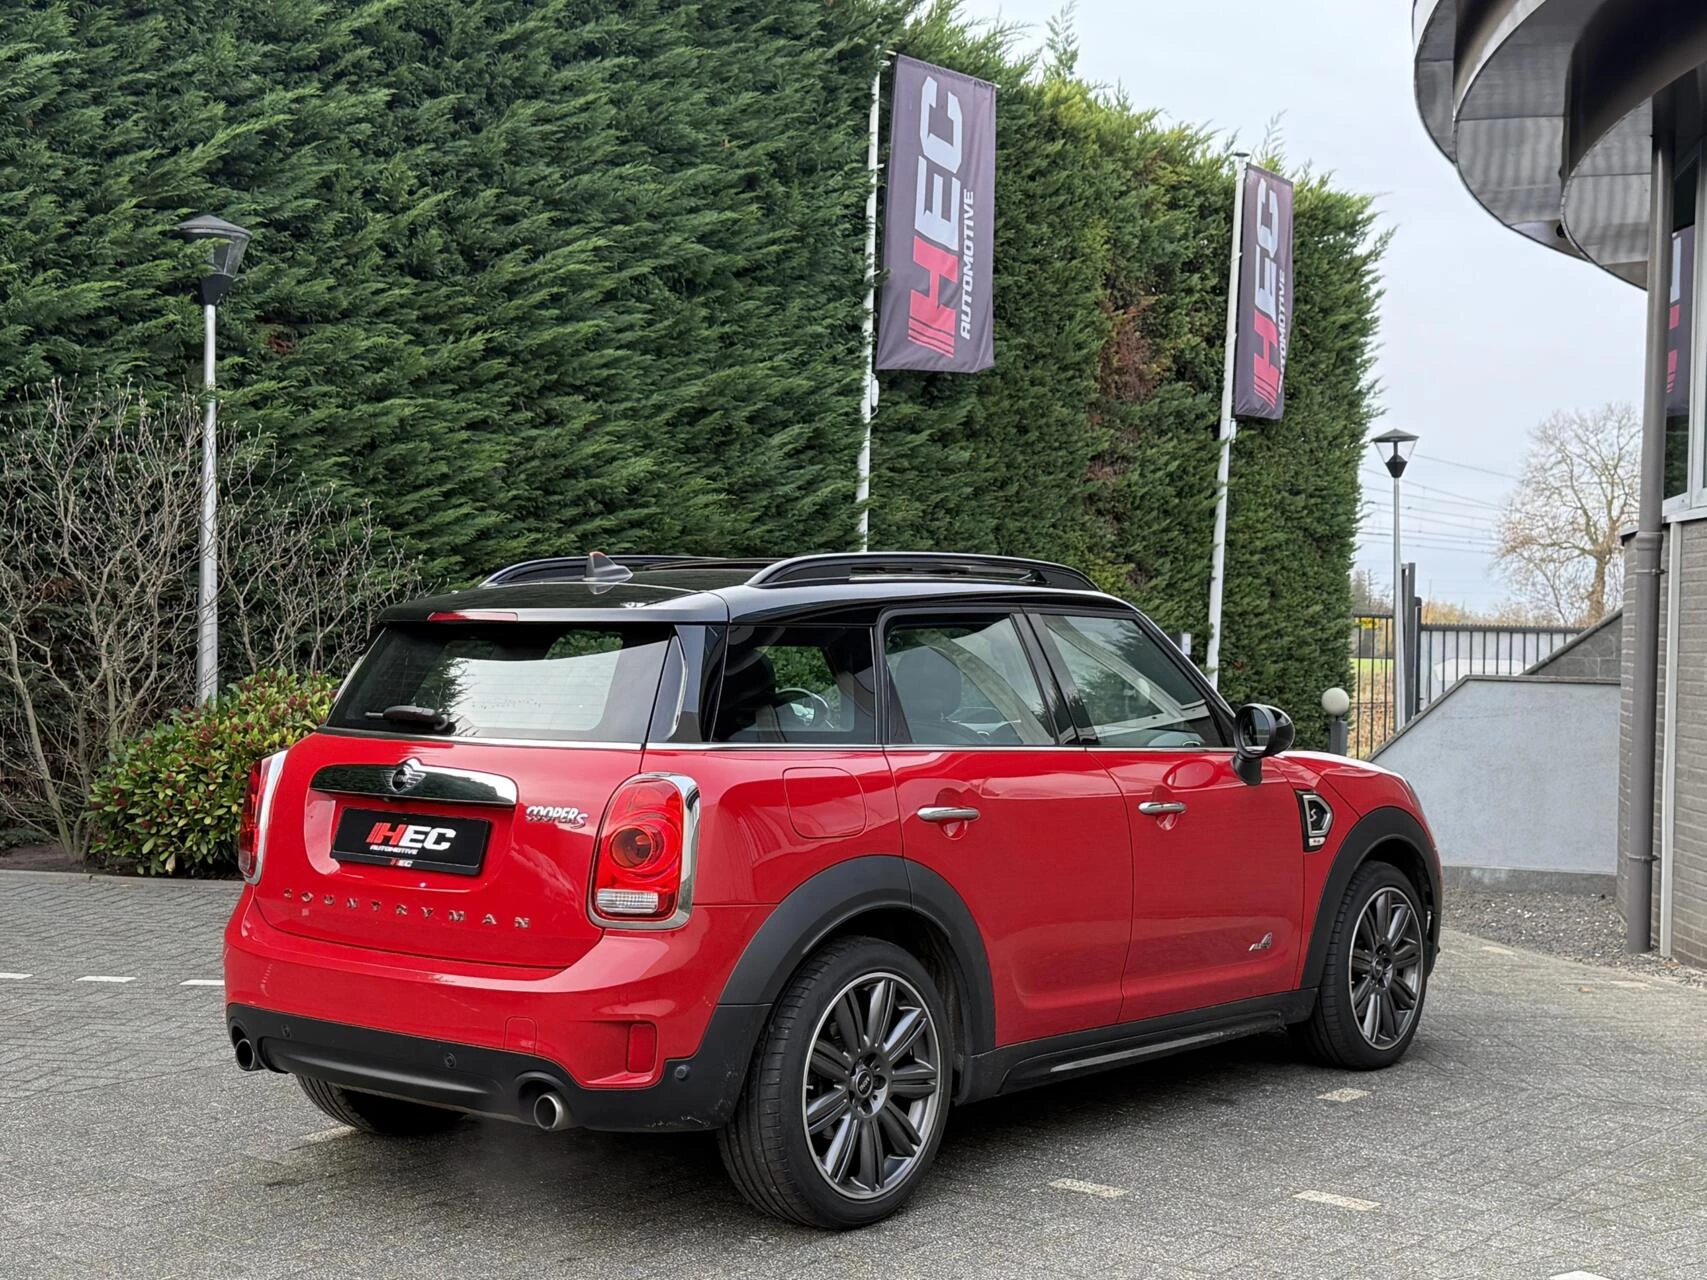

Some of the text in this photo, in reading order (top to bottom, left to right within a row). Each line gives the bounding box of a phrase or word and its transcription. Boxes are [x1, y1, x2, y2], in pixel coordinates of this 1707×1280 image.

[907, 75, 963, 358] HEC
[959, 188, 975, 340] AUTOMOTIVE
[1253, 177, 1280, 409] HEC
[526, 805, 579, 824] COOPER
[366, 822, 456, 850] HEC
[369, 844, 419, 856] AUTOMOTIVE
[282, 887, 530, 929] COUNTRYMAN
